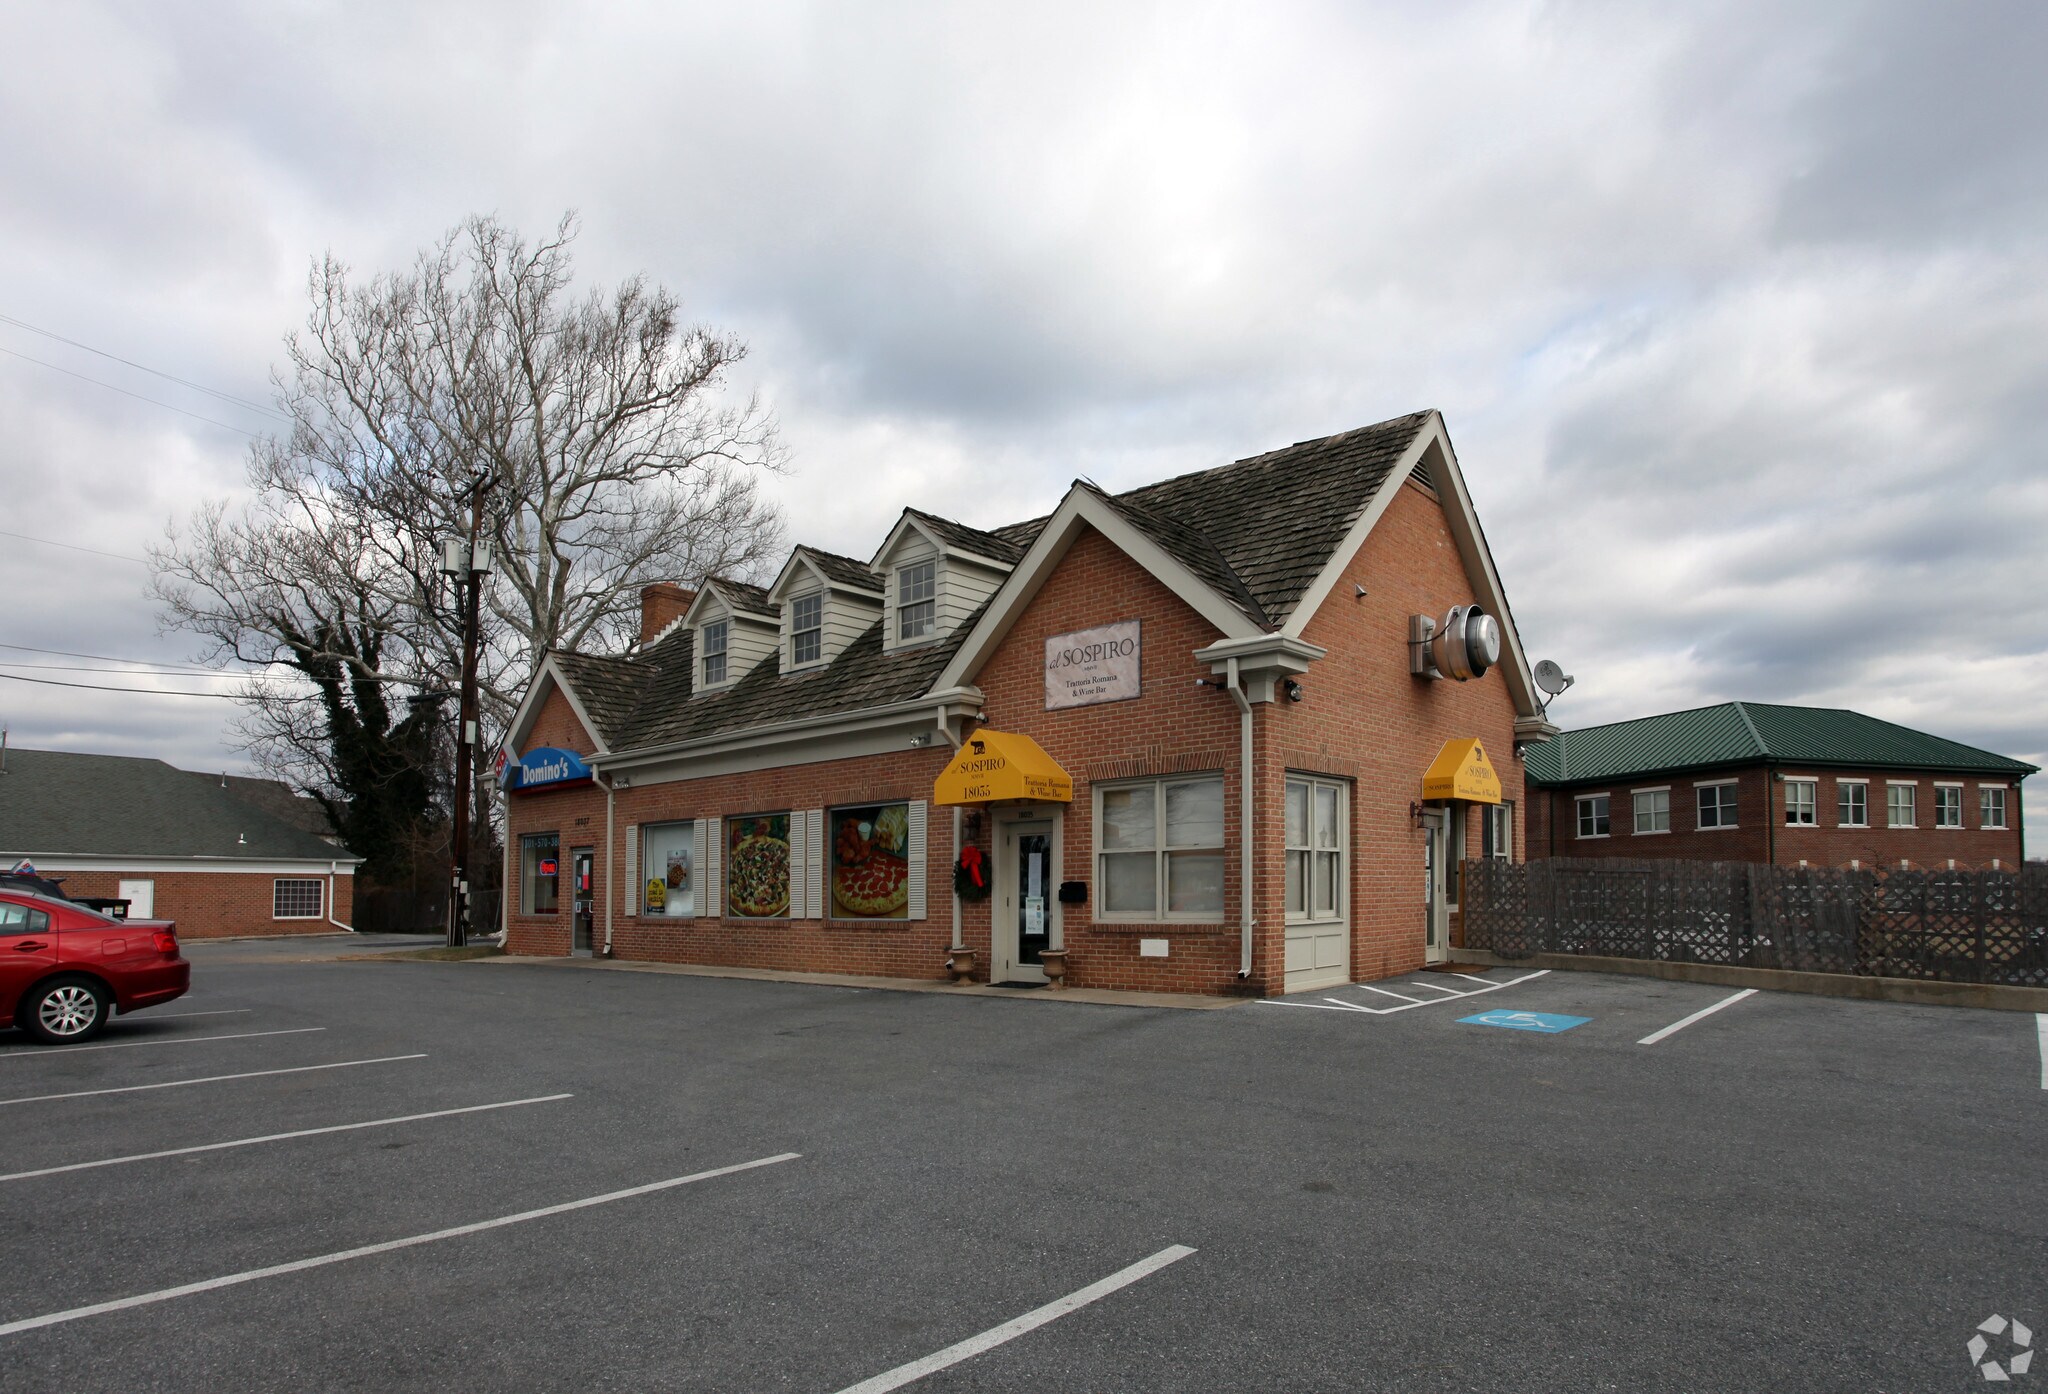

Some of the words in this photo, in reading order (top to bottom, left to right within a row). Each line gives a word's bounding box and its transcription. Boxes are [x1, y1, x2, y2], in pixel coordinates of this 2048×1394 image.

[1049, 651, 1061, 669] al
[1062, 638, 1135, 667] SOSPIRO
[1066, 679, 1091, 688] Trattoria
[1092, 675, 1118, 684] Romana
[1096, 686, 1106, 694] Bar
[522, 757, 569, 785] Domino's
[960, 758, 1006, 774] SOSPIRO
[1024, 776, 1048, 787] Trattoria
[1048, 778, 1070, 789] Romana
[963, 785, 991, 799] 18035
[1029, 788, 1036, 796] &
[1037, 787, 1051, 797] Wine
[1052, 789, 1062, 798] Bar
